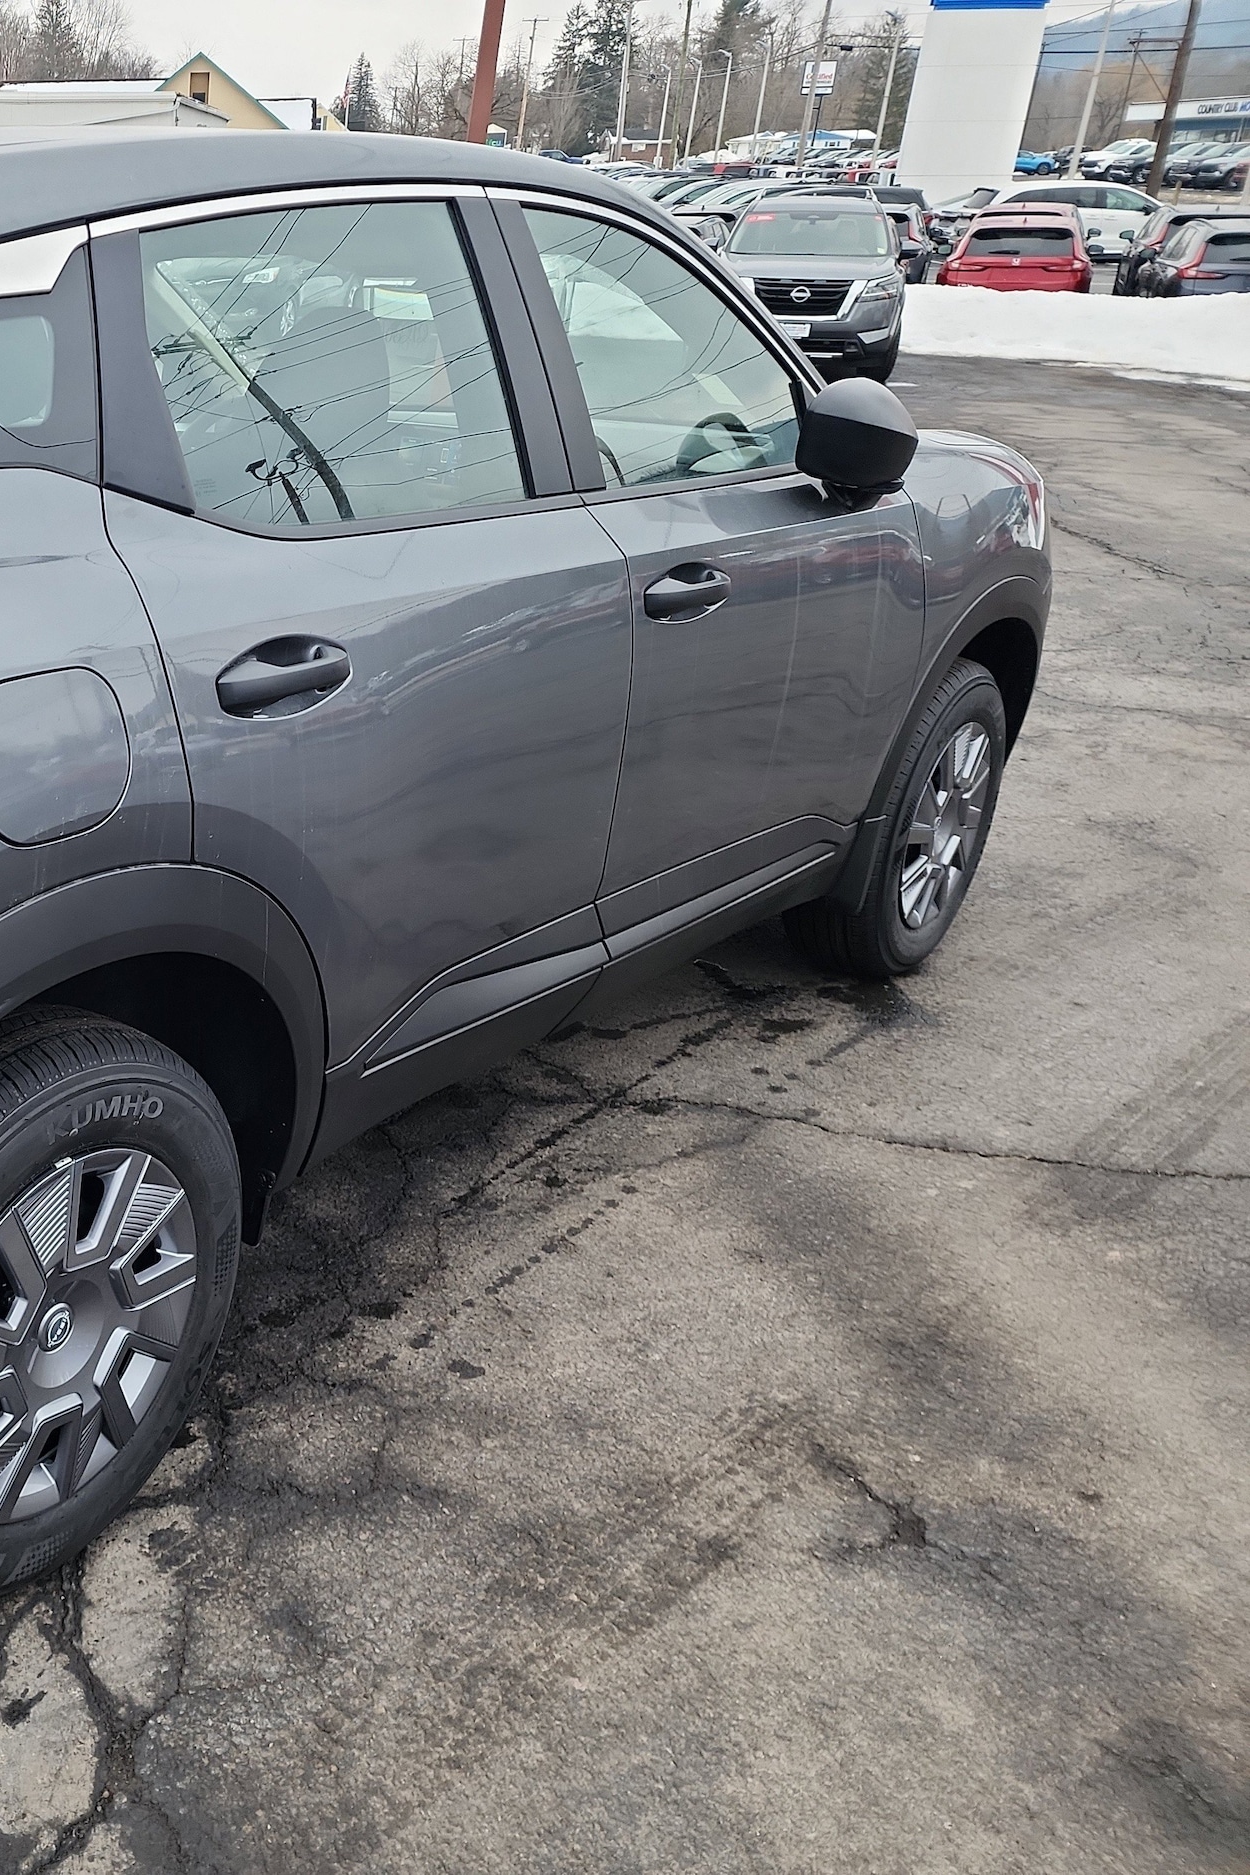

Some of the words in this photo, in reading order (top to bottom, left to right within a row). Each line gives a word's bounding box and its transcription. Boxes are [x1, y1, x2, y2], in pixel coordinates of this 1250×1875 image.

[1197, 103, 1224, 114] COUNTRY
[1224, 102, 1239, 112] CLUB
[47, 1094, 165, 1146] KUMHO
